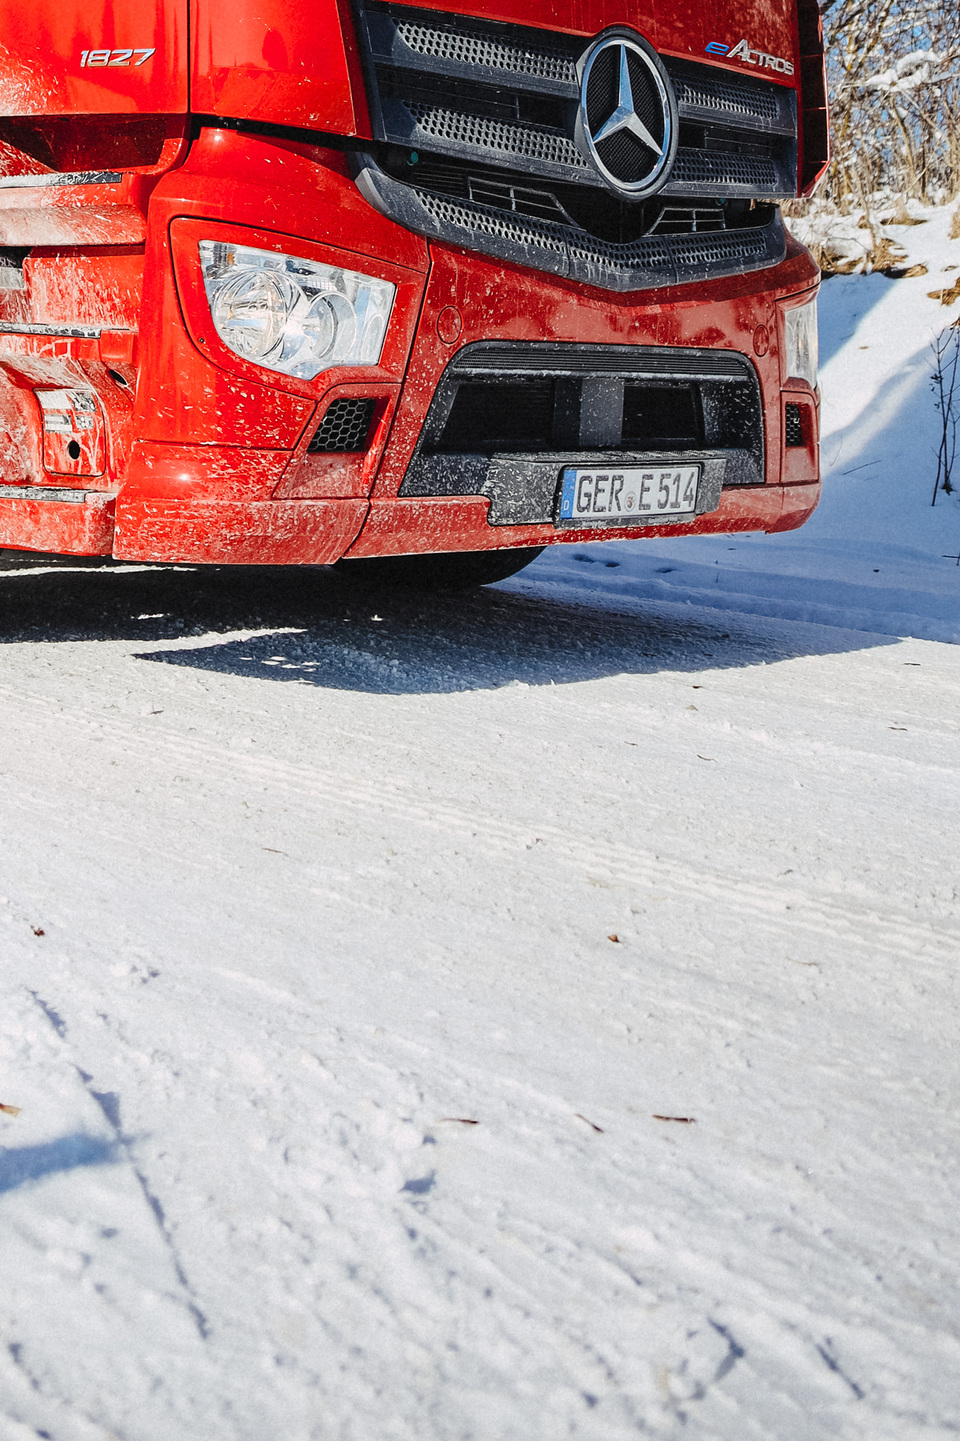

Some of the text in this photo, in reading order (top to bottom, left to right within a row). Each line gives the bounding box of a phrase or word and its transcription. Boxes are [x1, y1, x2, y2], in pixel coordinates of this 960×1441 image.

[80, 47, 156, 68] 1827
[576, 471, 696, 513] GER E 514
[563, 499, 570, 511] D
